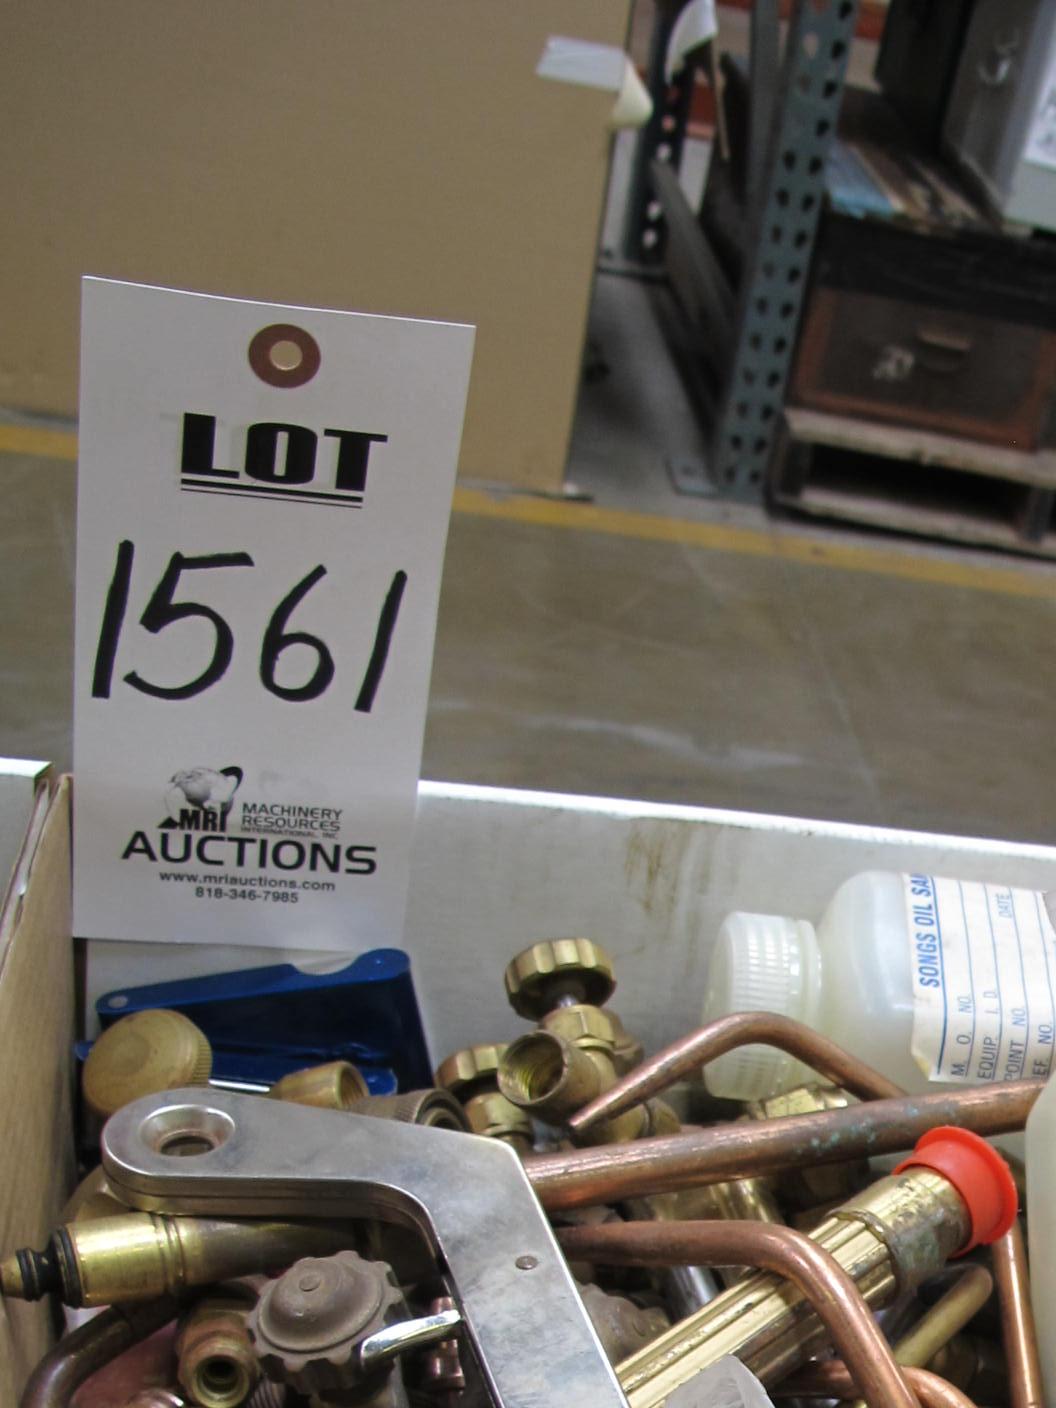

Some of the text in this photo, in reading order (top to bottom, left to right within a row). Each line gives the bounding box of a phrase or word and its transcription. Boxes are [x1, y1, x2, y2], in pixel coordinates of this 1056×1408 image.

[181, 412, 388, 492] LOT
[92, 540, 408, 713] 1561
[178, 803, 228, 832] MRI
[242, 802, 343, 820] MACHINERY
[241, 816, 341, 832] RESOURCES
[121, 830, 378, 875] AUCTIONS
[159, 872, 336, 891] www.mriauctions.com
[195, 886, 299, 903] 818-346-7985
[996, 893, 1013, 919] DATE
[913, 904, 934, 926] OIL
[916, 932, 939, 988] SONGS
[1032, 1057, 1049, 1080] EF.
